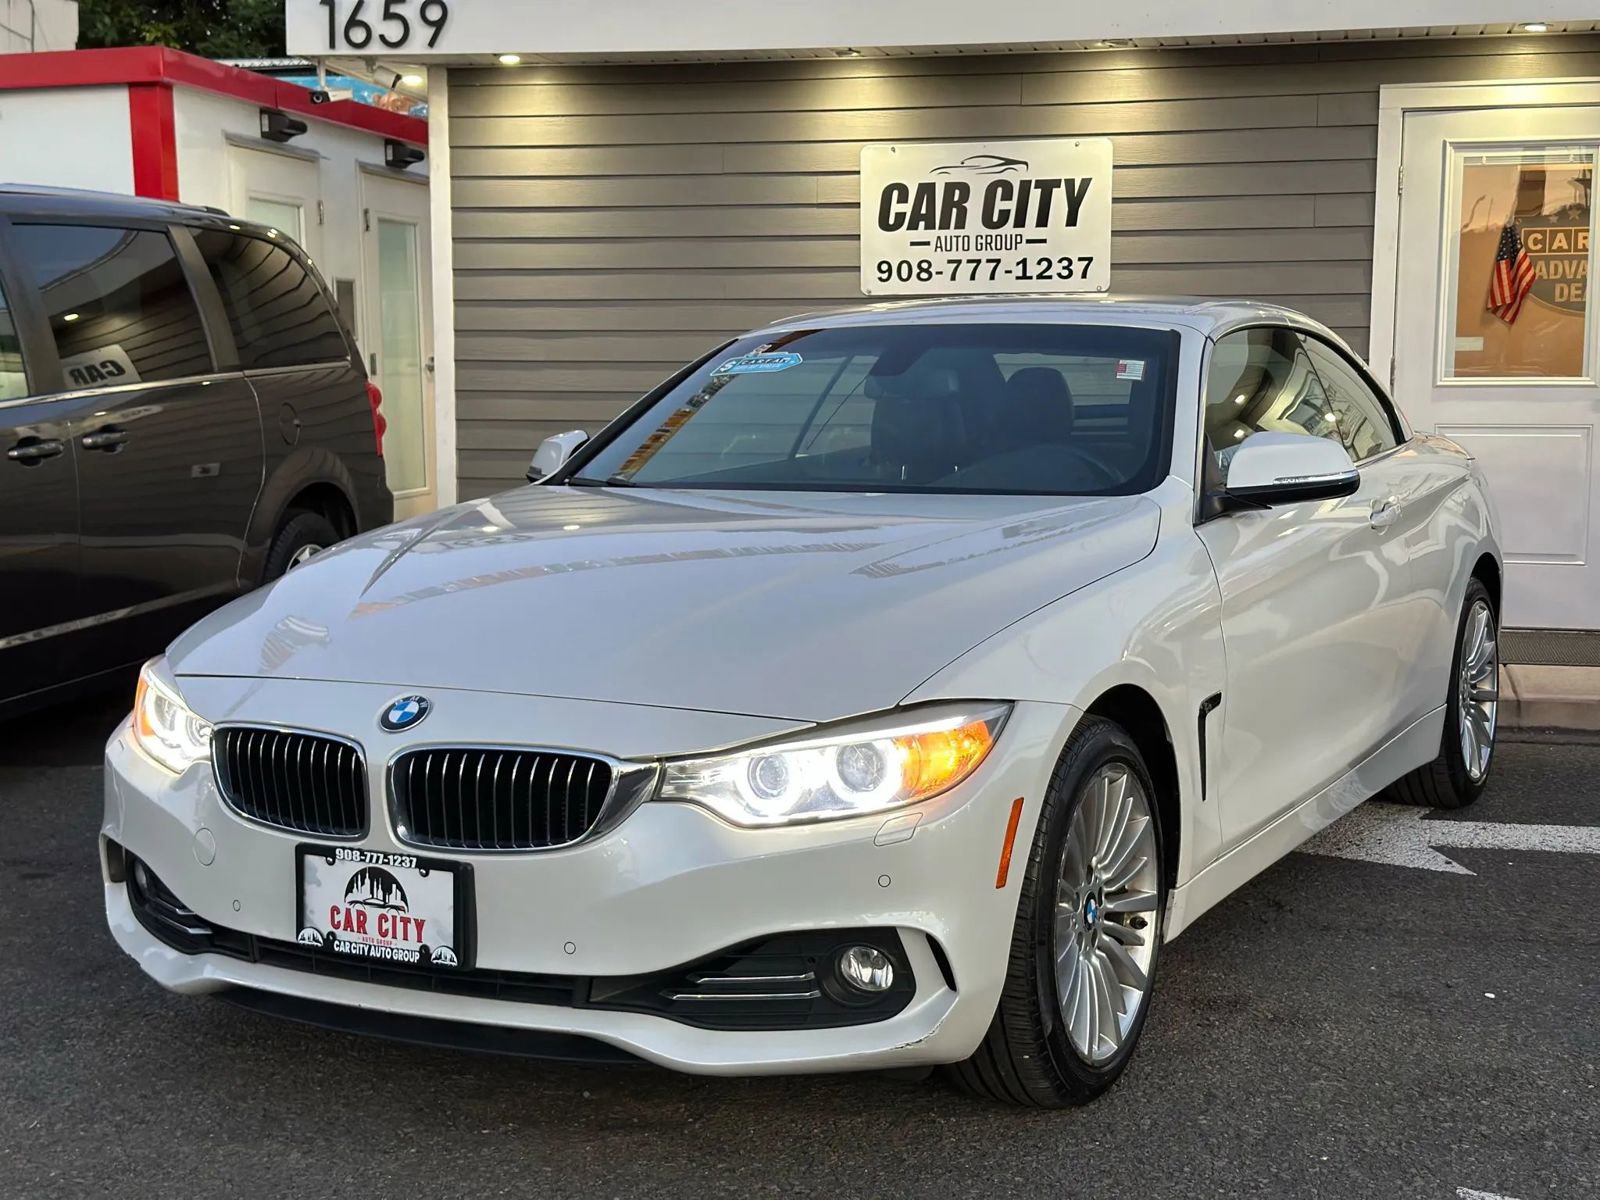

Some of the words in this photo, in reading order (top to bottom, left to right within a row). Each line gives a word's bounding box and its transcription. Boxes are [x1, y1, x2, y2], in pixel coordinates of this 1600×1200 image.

[319, 0, 448, 49] 1659
[877, 181, 971, 232] CAR
[981, 177, 1093, 230] CITY
[934, 235, 971, 252] AUTO
[976, 233, 1023, 251] GROUP
[877, 256, 1094, 283] 908-777-1237
[1554, 283, 1586, 302] DE
[335, 848, 417, 869] 908-777-1237
[330, 905, 368, 935] CAR
[377, 913, 426, 943] CITY
[333, 940, 350, 954] CAR
[351, 942, 369, 957] CITY
[369, 945, 392, 959] AUTO
[392, 948, 420, 963] GROUP
